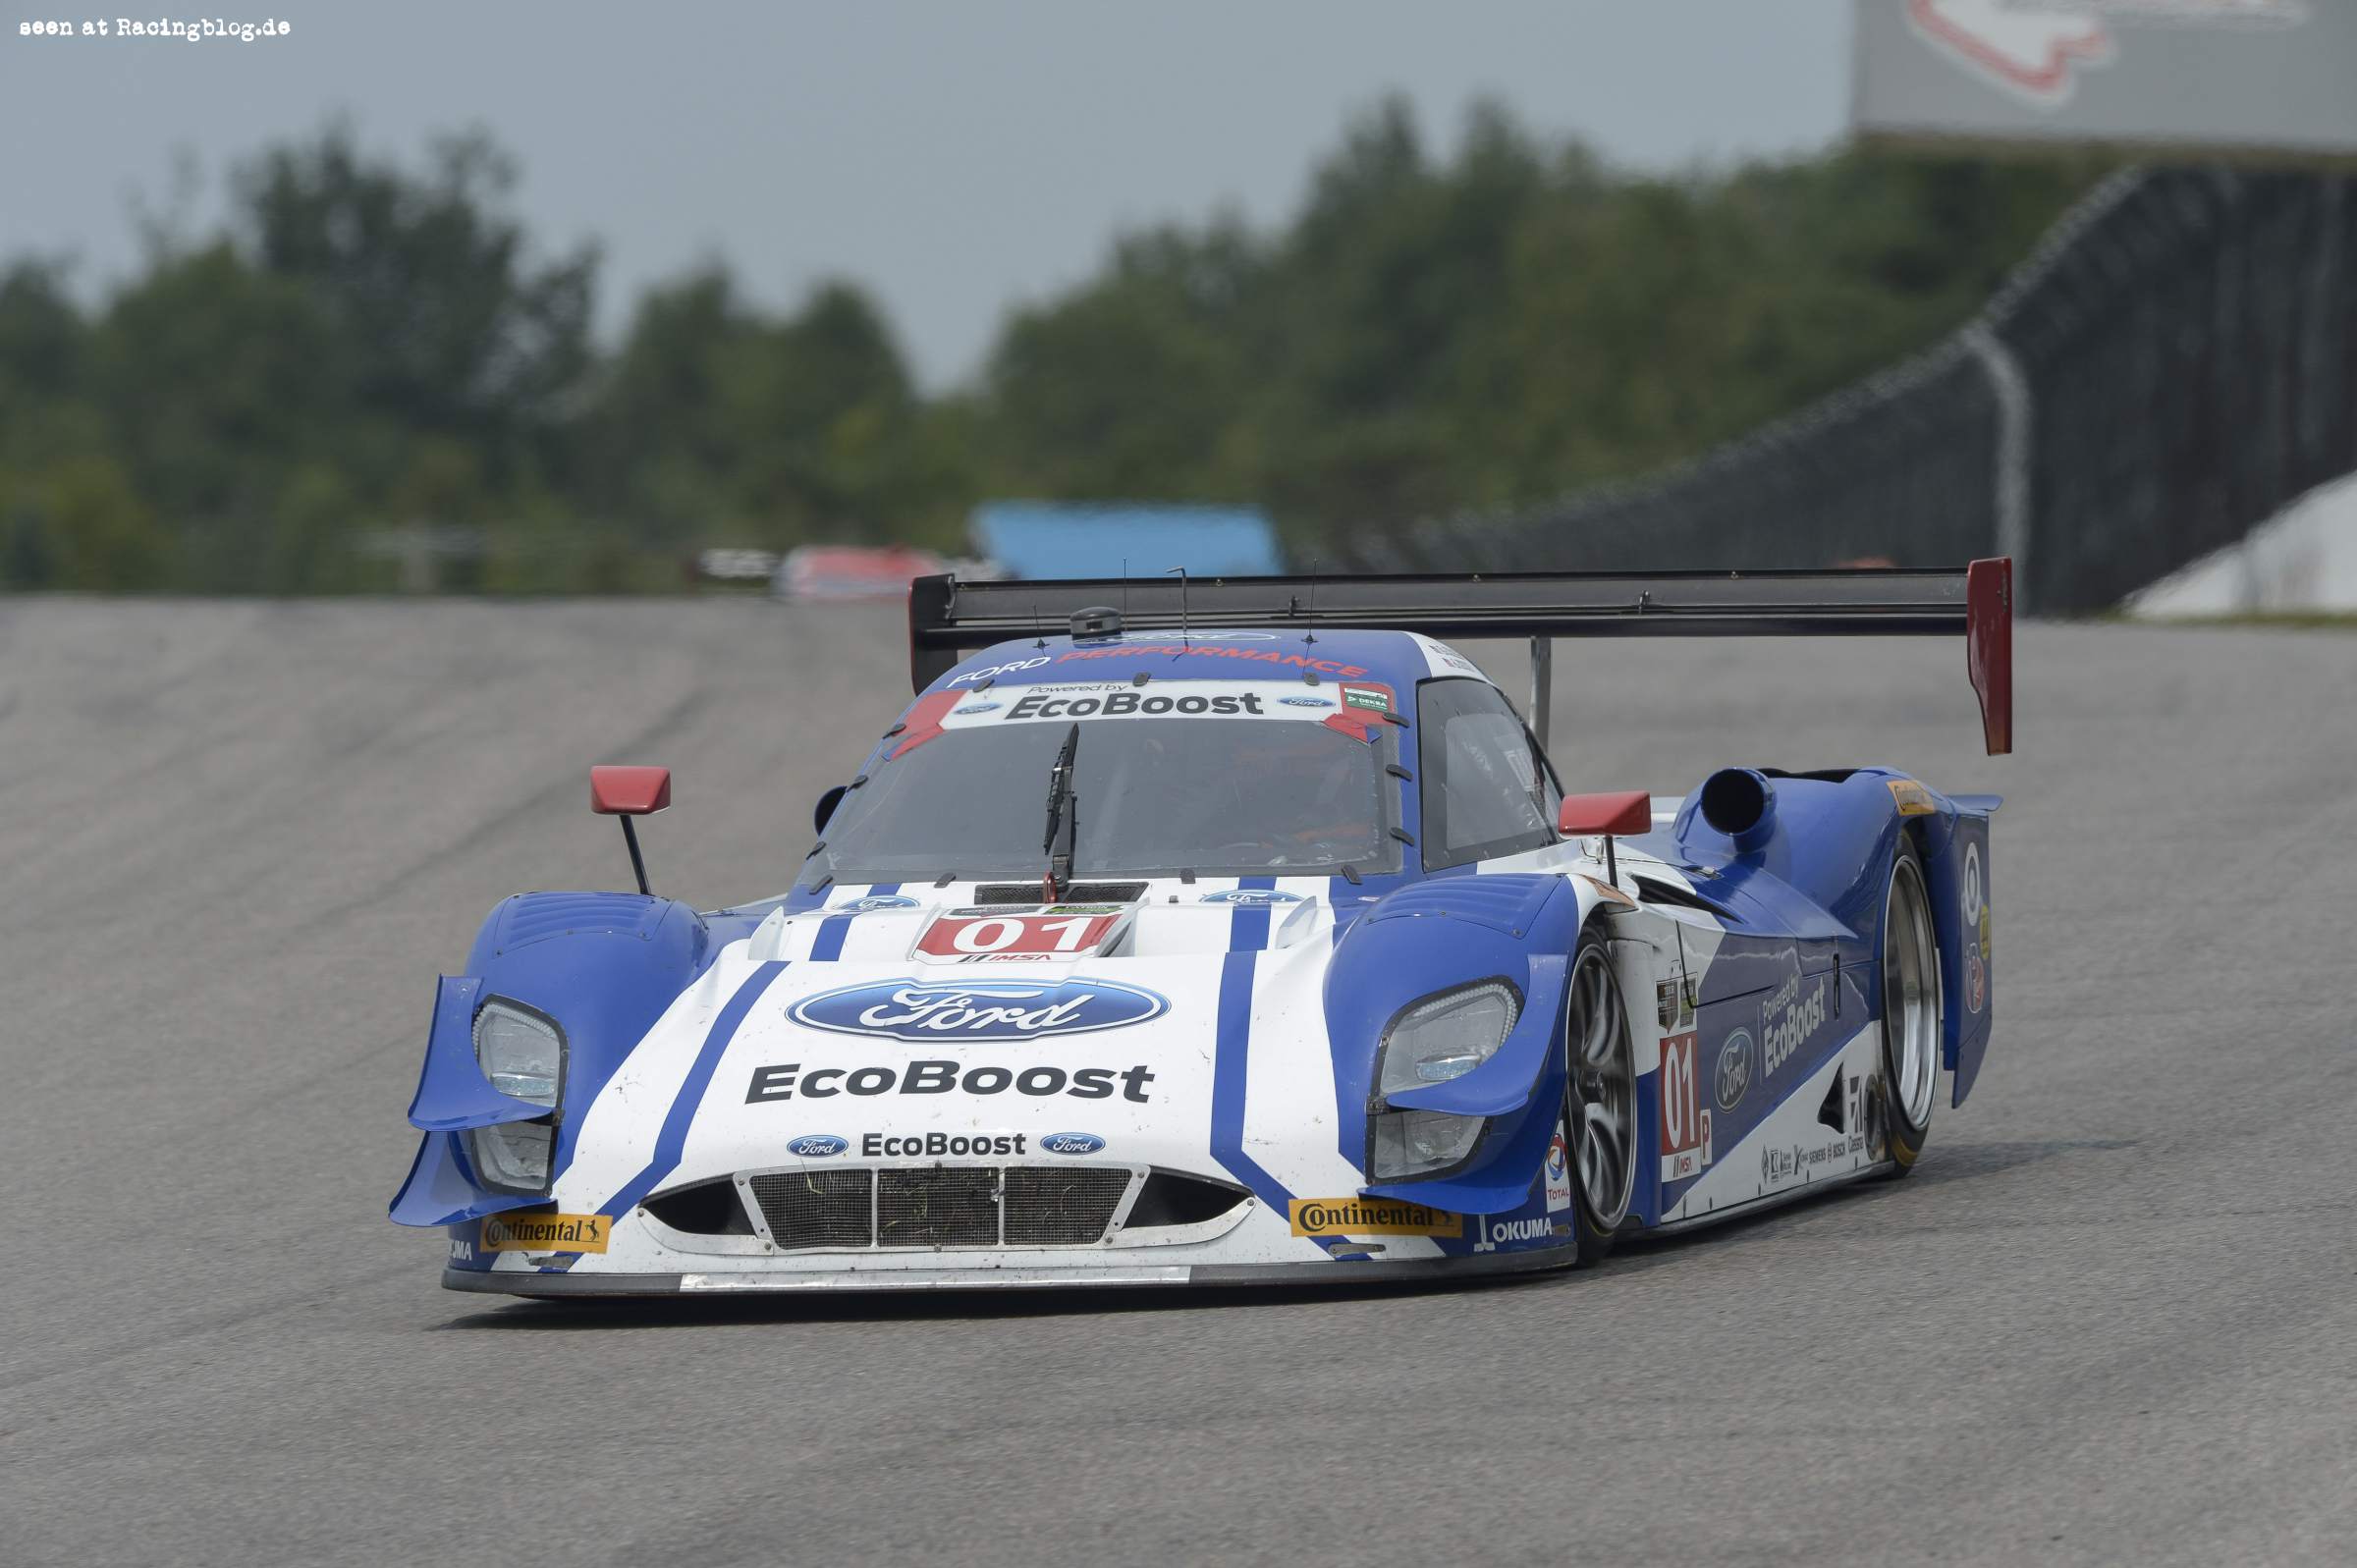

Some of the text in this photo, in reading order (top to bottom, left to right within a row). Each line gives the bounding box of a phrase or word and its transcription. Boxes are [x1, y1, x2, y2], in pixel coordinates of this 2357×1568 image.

[946, 644, 1369, 689] FORD PERFORMANCE
[1027, 682, 1129, 695] Powered by
[1358, 697, 1388, 708] DEKRA
[1004, 691, 1265, 721] EcoBoost
[953, 917, 1095, 953] 01
[989, 953, 1052, 962] IMSA
[858, 988, 1097, 1031] Ford
[1762, 982, 1791, 1024] Powered
[1764, 975, 1826, 1078] EcoBoost
[743, 1059, 1157, 1105] EcoBoost
[1722, 1042, 1747, 1102] Ford
[1664, 1037, 1696, 1150] 01
[797, 1136, 837, 1156] Ford
[860, 1131, 1027, 1158] EcoBoost
[1052, 1135, 1092, 1154] Ford
[1702, 1115, 1710, 1160] P
[1833, 1140, 1846, 1160] BOSCH
[1808, 1147, 1827, 1165] SIEMENS
[1547, 1186, 1570, 1201] TOTAL
[1298, 1201, 1435, 1232] Continental
[1492, 1217, 1554, 1241] OKUMA
[484, 1217, 583, 1248] Continental
